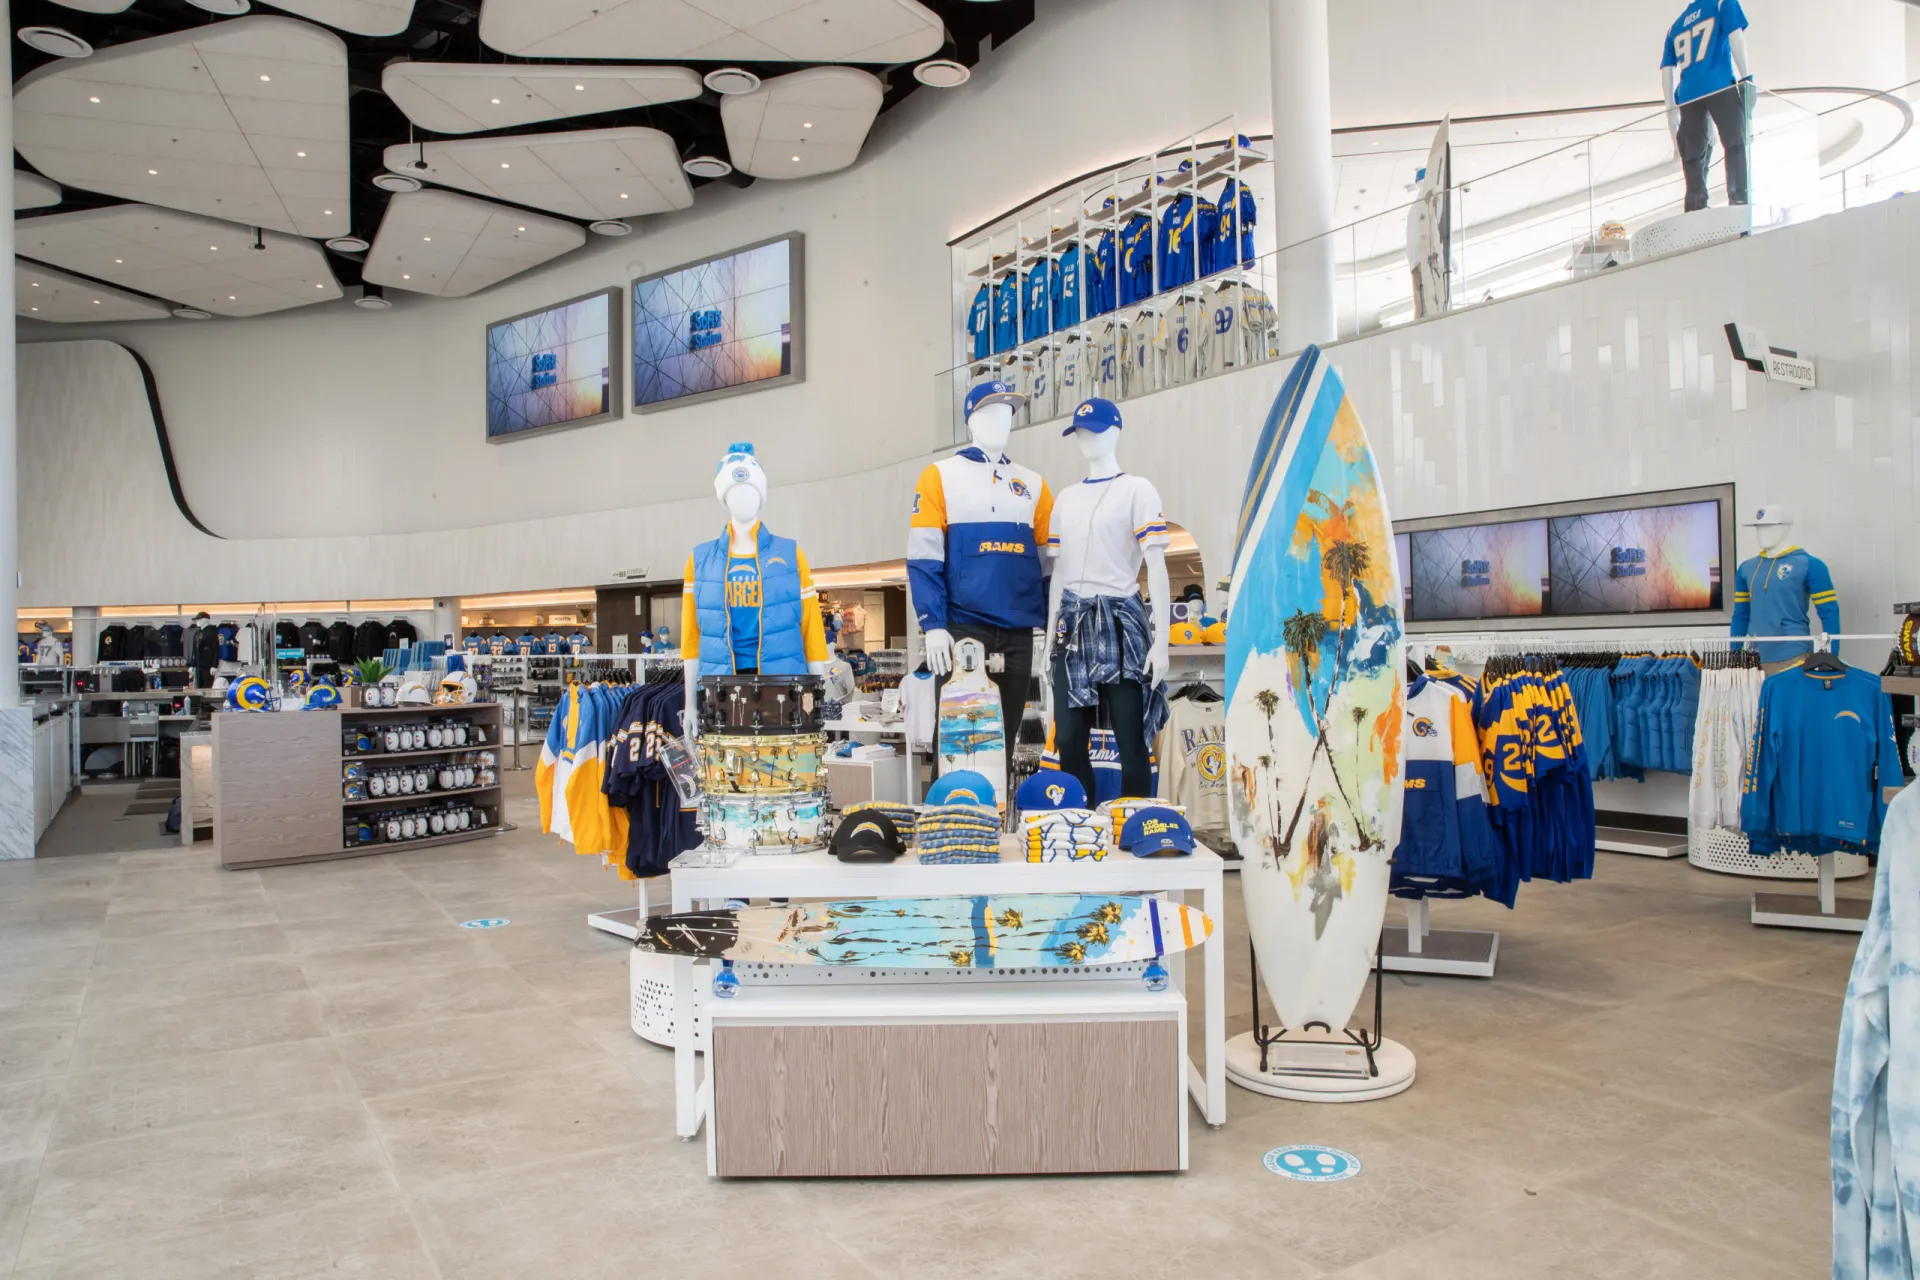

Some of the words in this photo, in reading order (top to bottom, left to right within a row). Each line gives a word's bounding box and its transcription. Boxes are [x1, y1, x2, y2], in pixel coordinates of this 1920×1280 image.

[1673, 17, 1715, 70] 97
[1214, 305, 1234, 335] 99
[1772, 360, 1812, 381] RESTROOMS
[979, 541, 1025, 554] RAMS
[1904, 619, 1914, 662] RAMS
[1181, 725, 1225, 753] RAM
[1088, 749, 1120, 761] ams
[1503, 742, 1521, 770] 2
[1404, 778, 1425, 788] MS
[1142, 818, 1158, 827] LOS
[1143, 823, 1179, 831] ANGELES
[1144, 828, 1167, 836] RAMS
